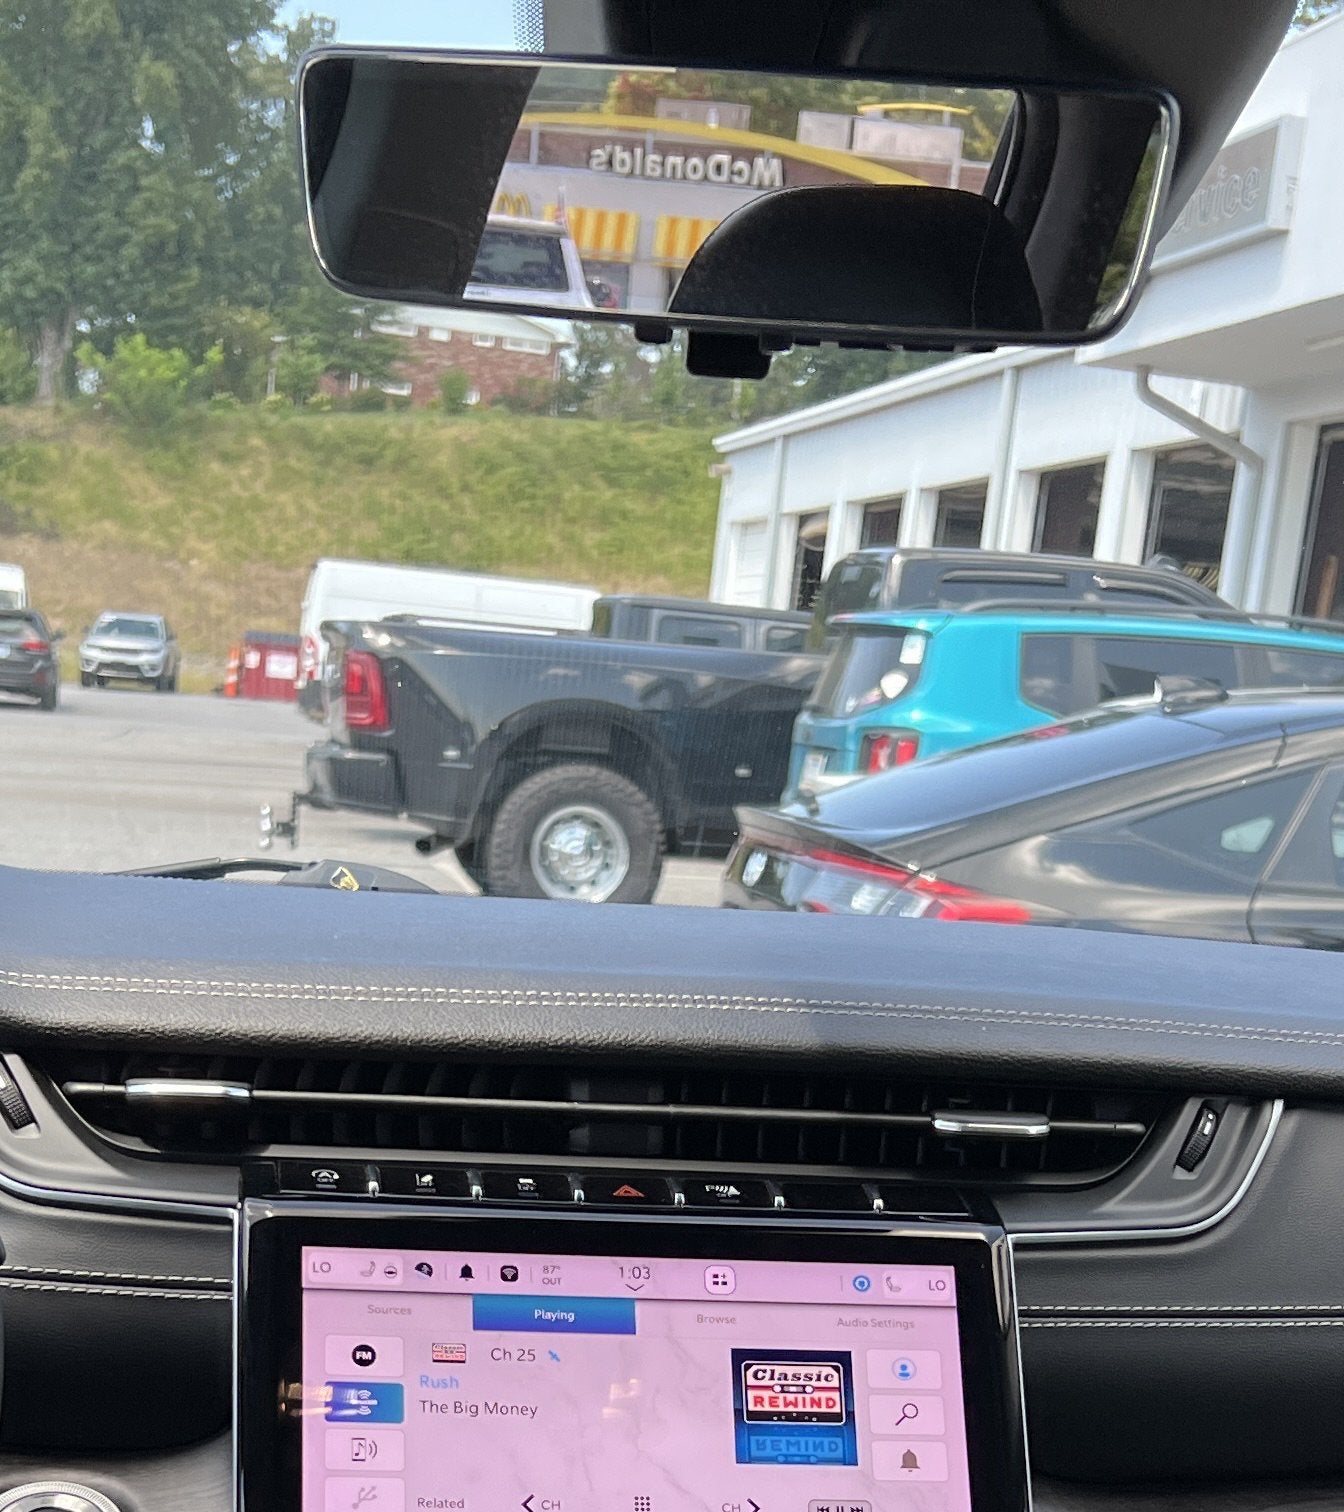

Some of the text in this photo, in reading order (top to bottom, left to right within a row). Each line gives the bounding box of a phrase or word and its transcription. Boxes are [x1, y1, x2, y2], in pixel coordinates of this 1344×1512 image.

[312, 1262, 331, 1273] LO
[618, 1266, 651, 1280] 1:03
[542, 1277, 562, 1286] OUT
[928, 1279, 946, 1291] LO
[367, 1304, 412, 1316] Sources
[534, 1308, 575, 1323] Playing
[696, 1314, 737, 1325] Browse
[837, 1317, 915, 1331] Audio Settings
[356, 1351, 373, 1360] FM
[491, 1348, 536, 1362] Ch 25
[752, 1367, 835, 1382] Classic
[419, 1375, 460, 1389] Rush
[419, 1400, 538, 1418] The Big Money
[753, 1395, 837, 1410] REWIND
[417, 1497, 465, 1510] Related
[541, 1500, 561, 1511] CH
